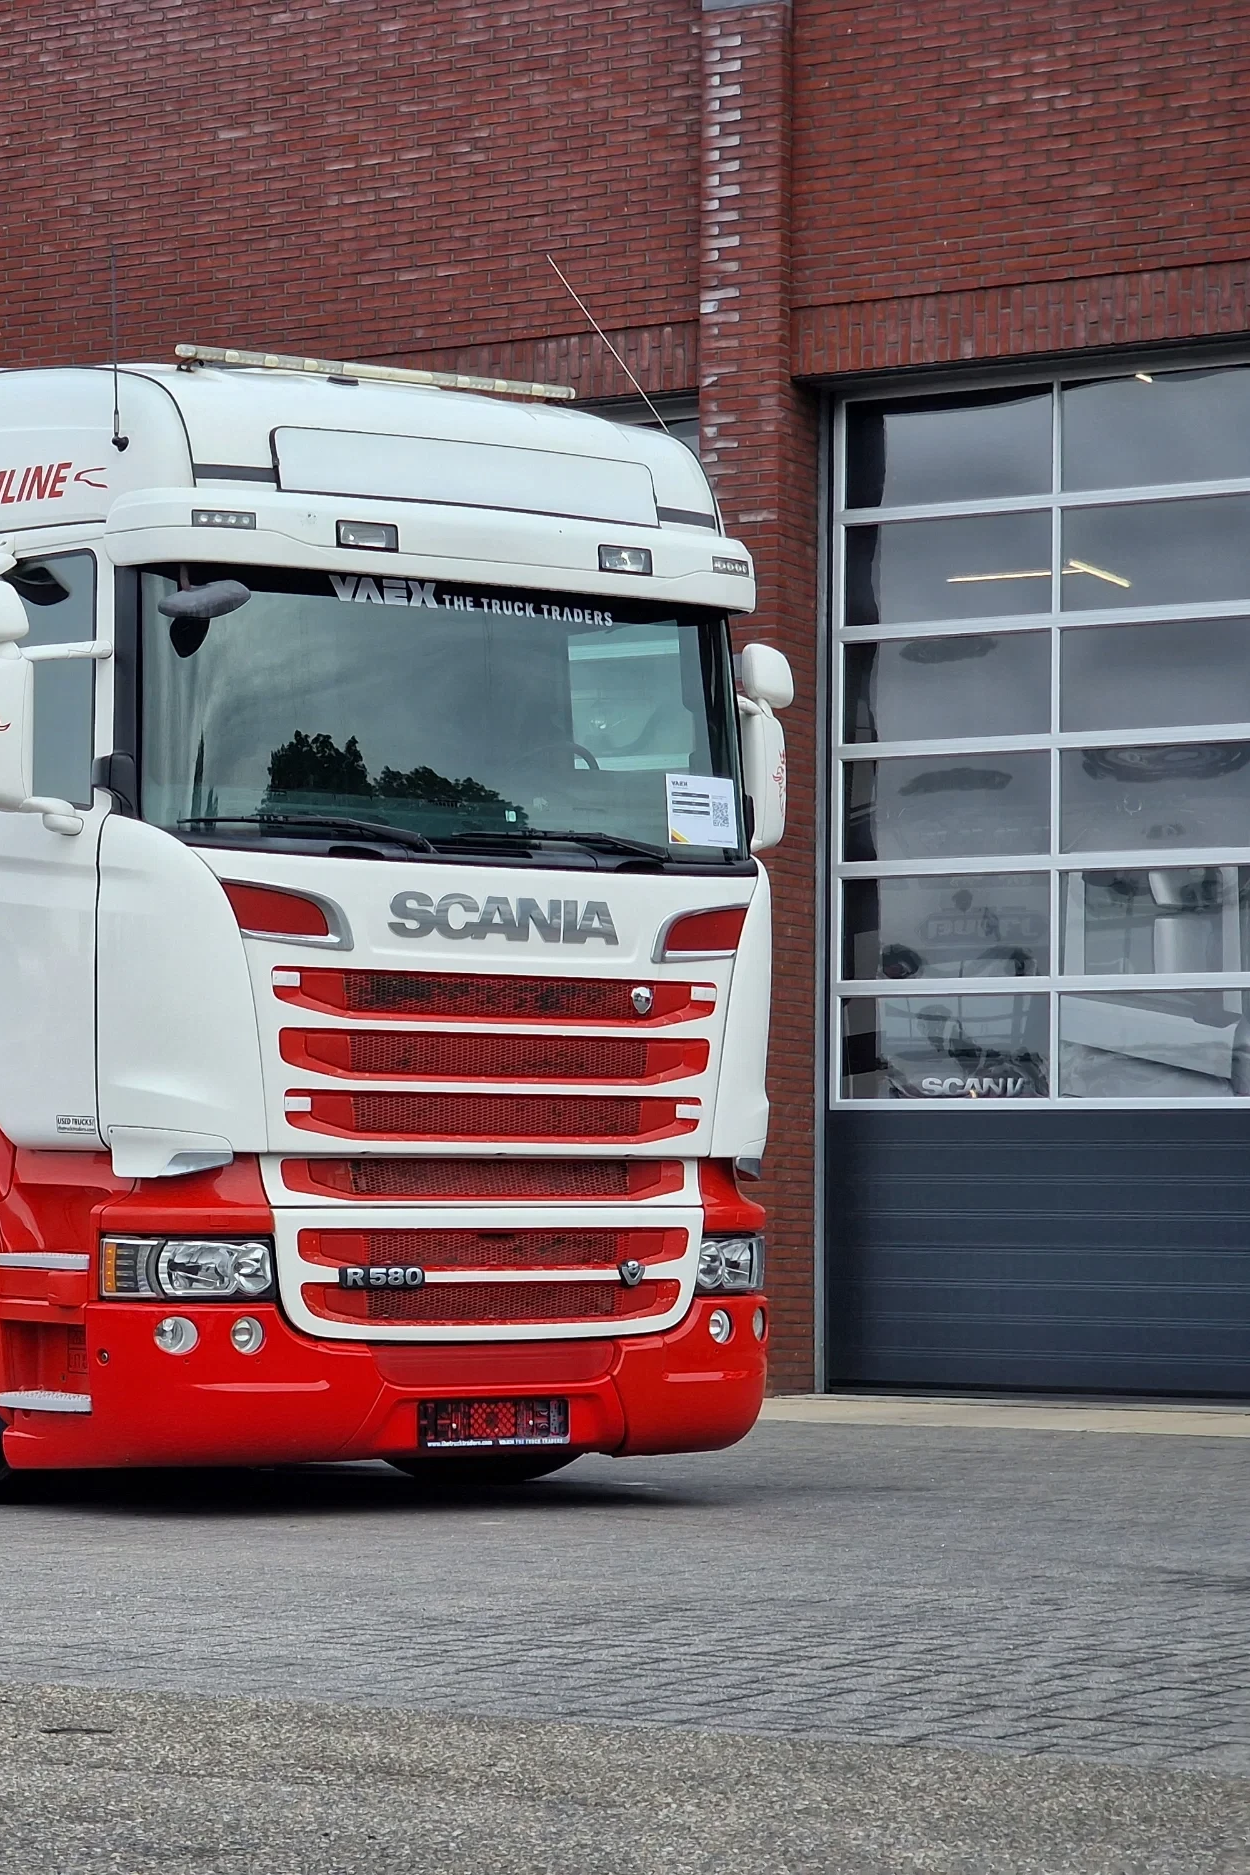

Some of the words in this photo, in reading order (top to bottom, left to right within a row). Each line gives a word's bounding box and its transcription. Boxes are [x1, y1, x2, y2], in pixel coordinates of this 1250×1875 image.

[328, 575, 438, 609] VAEX
[442, 594, 475, 612] THE
[481, 598, 536, 618] TRUCK
[541, 604, 613, 627] TRADERS
[387, 891, 619, 945] SCANIA
[57, 1117, 71, 1125] USED
[369, 1267, 423, 1287] 580
